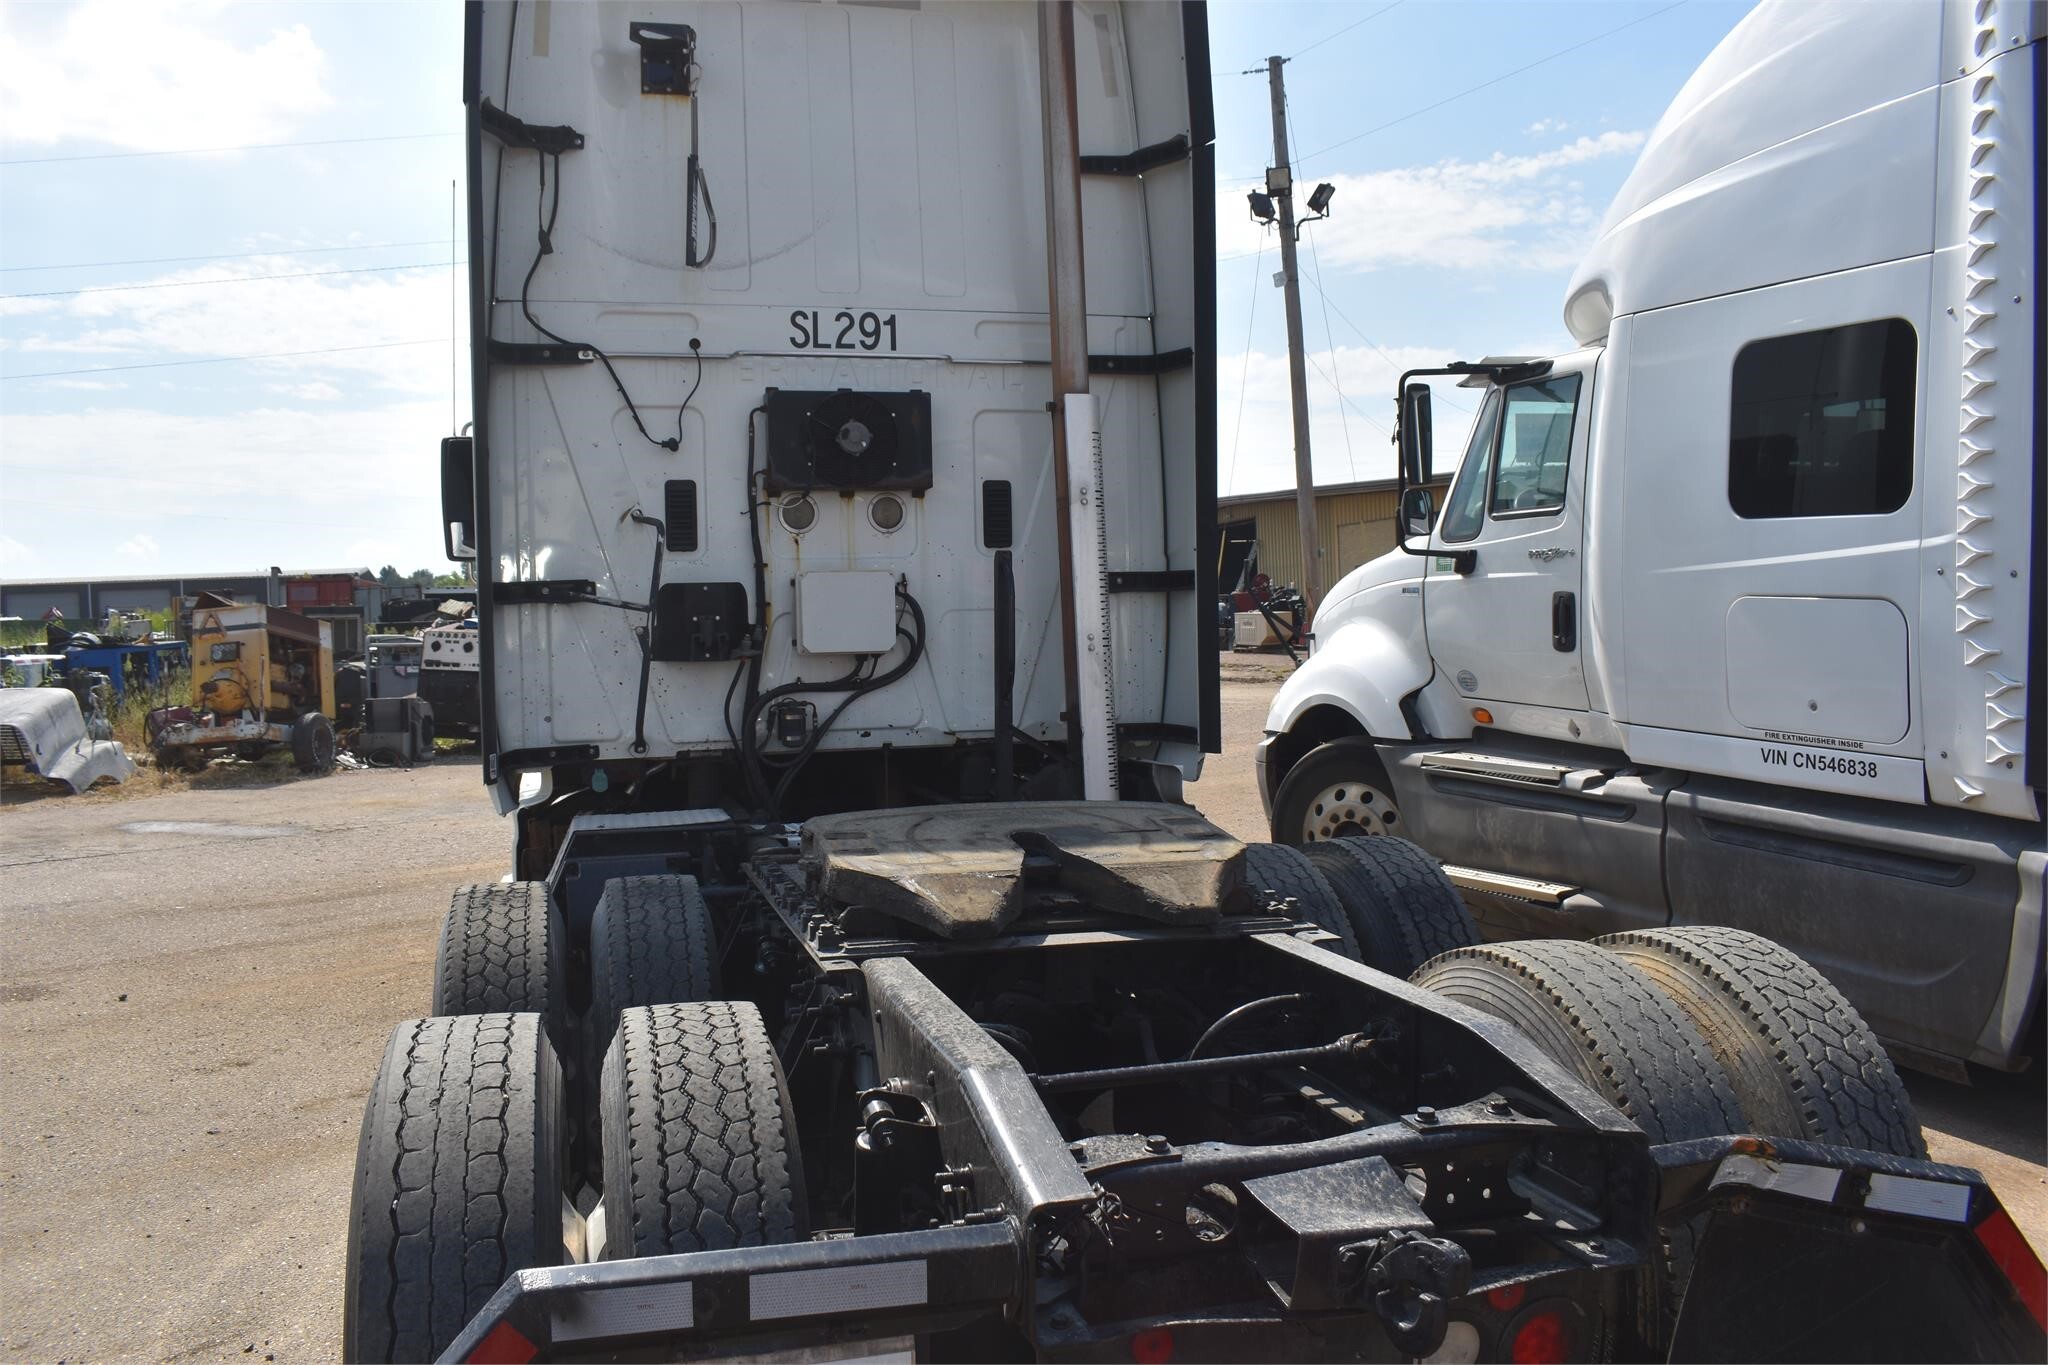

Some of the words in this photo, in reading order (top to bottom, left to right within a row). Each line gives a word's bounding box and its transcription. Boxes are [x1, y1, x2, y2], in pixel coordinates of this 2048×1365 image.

[789, 310, 897, 351] SL291
[1764, 731, 1781, 740] FIRE
[1783, 735, 1837, 746] EXTINGUISHER
[1838, 740, 1864, 750] INSIDE
[1760, 748, 1788, 766] VIN
[1793, 752, 1878, 778] CN546838
